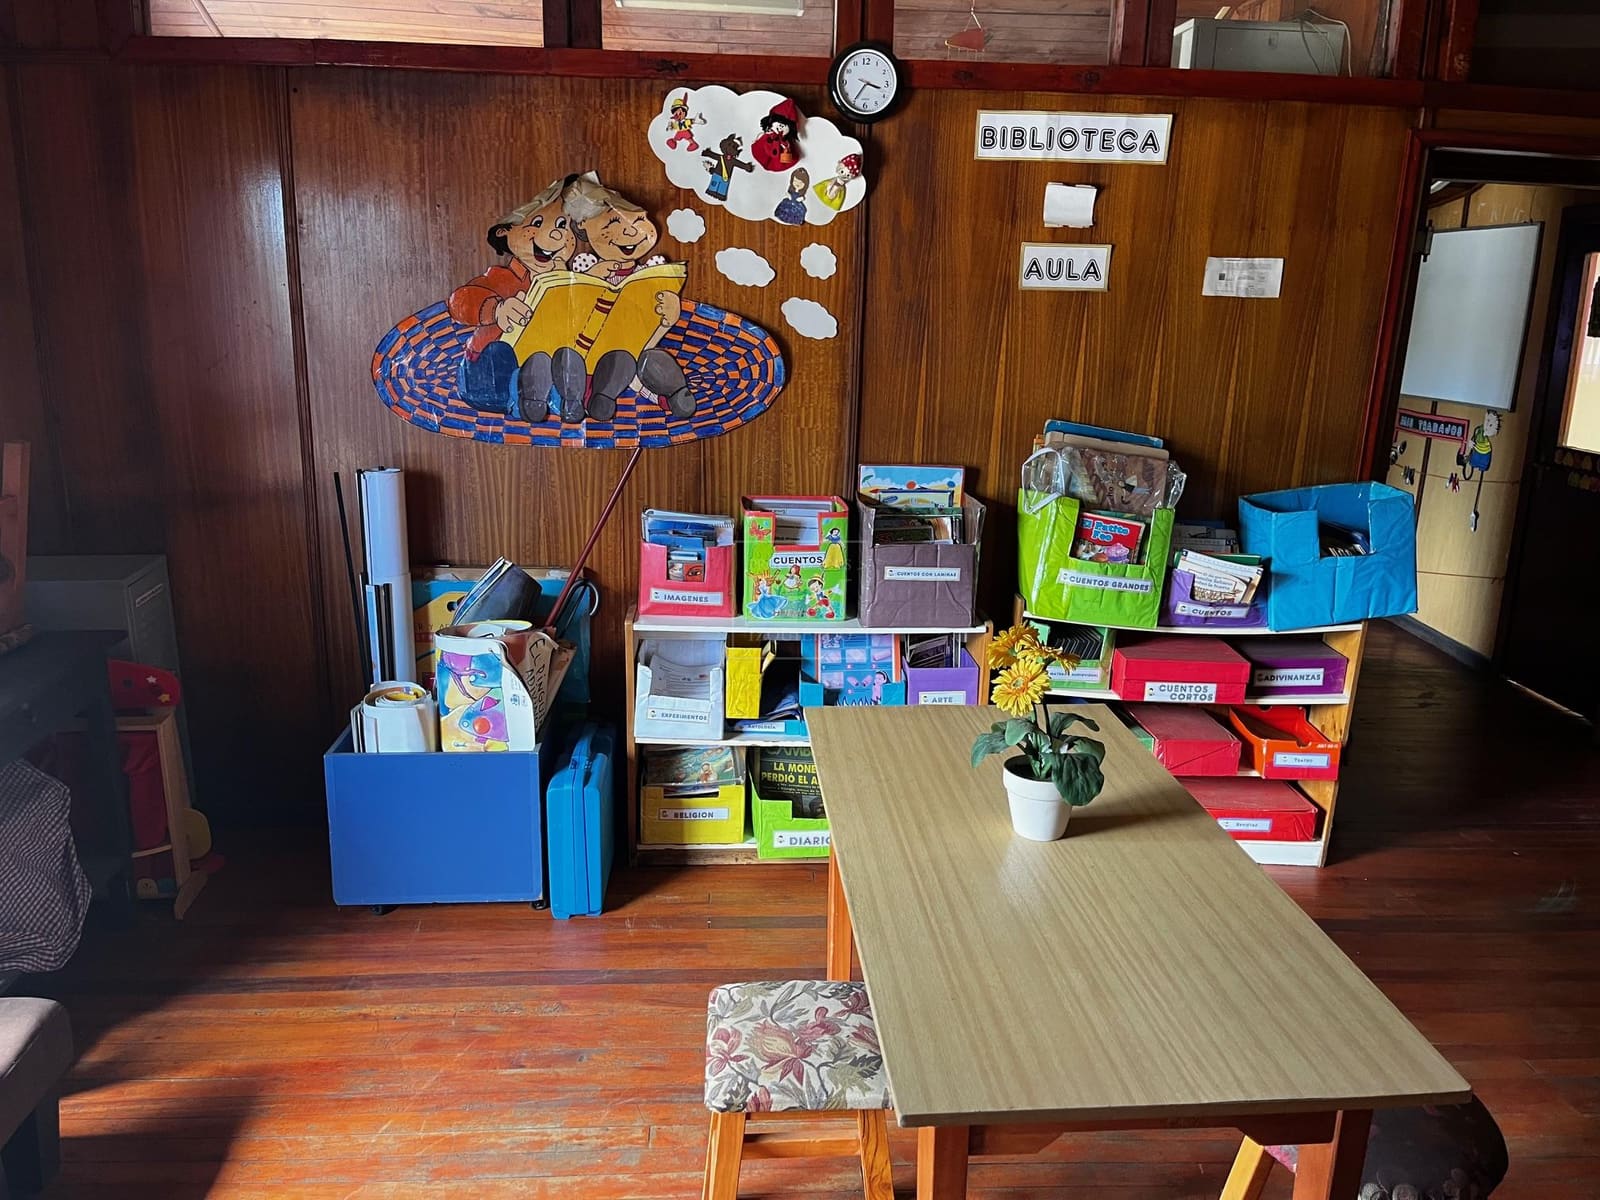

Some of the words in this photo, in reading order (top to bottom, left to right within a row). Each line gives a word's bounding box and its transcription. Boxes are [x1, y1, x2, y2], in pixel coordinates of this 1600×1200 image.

[862, 57, 871, 65] 12
[884, 80, 889, 88] 3
[981, 126, 1160, 153] BIBLIOTECA
[1024, 257, 1101, 281] AULA
[1094, 520, 1129, 535] Patito
[1091, 529, 1113, 541] Feo
[773, 556, 823, 565] CUENTOS
[1069, 574, 1109, 588] CUENTOS
[1111, 579, 1150, 592] GRANDES
[664, 593, 709, 603] IMAGENES
[1192, 608, 1232, 616] CUENTOS
[529, 638, 546, 667] EL
[1264, 673, 1321, 682] ADIVINANZAS
[1158, 684, 1209, 693] CUENTOS
[1170, 692, 1214, 702] CORTOS
[661, 712, 707, 721] EXPERIMENTOS
[773, 762, 785, 771] LA
[761, 772, 795, 783] PERDIÓ
[798, 775, 808, 784] EL
[674, 811, 714, 819] RELIGION
